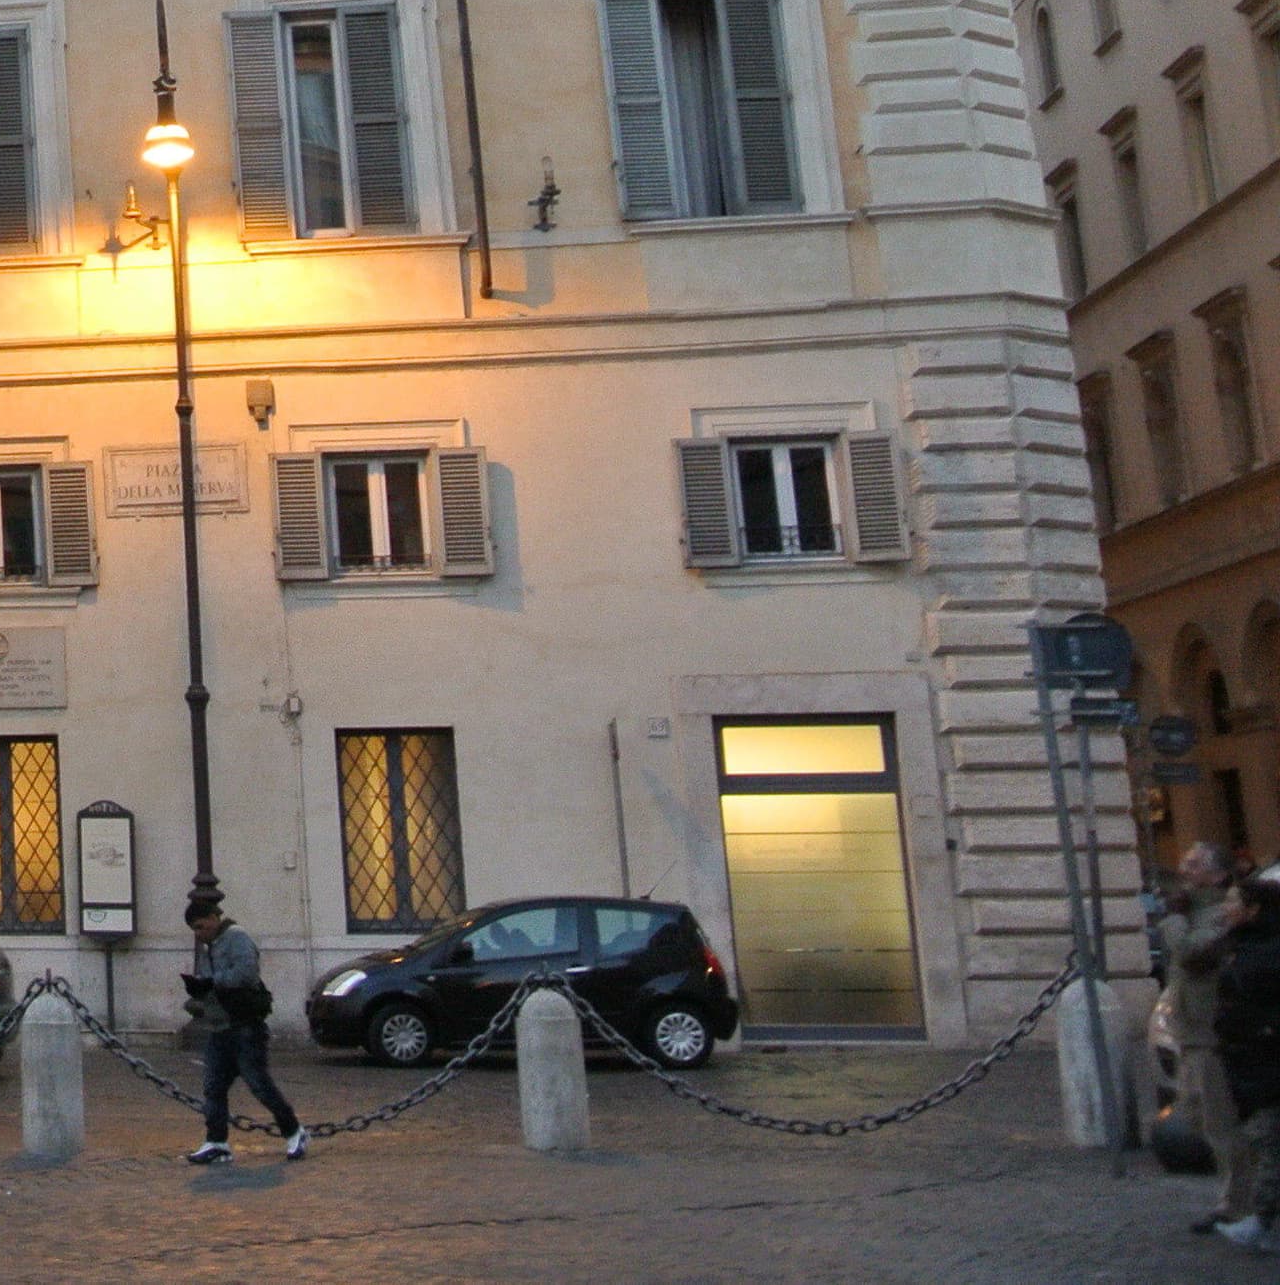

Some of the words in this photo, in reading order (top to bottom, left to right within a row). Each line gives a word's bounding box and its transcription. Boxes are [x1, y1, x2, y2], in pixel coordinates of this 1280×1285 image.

[146, 464, 203, 478] PIAZA
[118, 485, 162, 500] DELLA
[168, 481, 234, 498] MERVA
[88, 802, 121, 813] HOTEL
